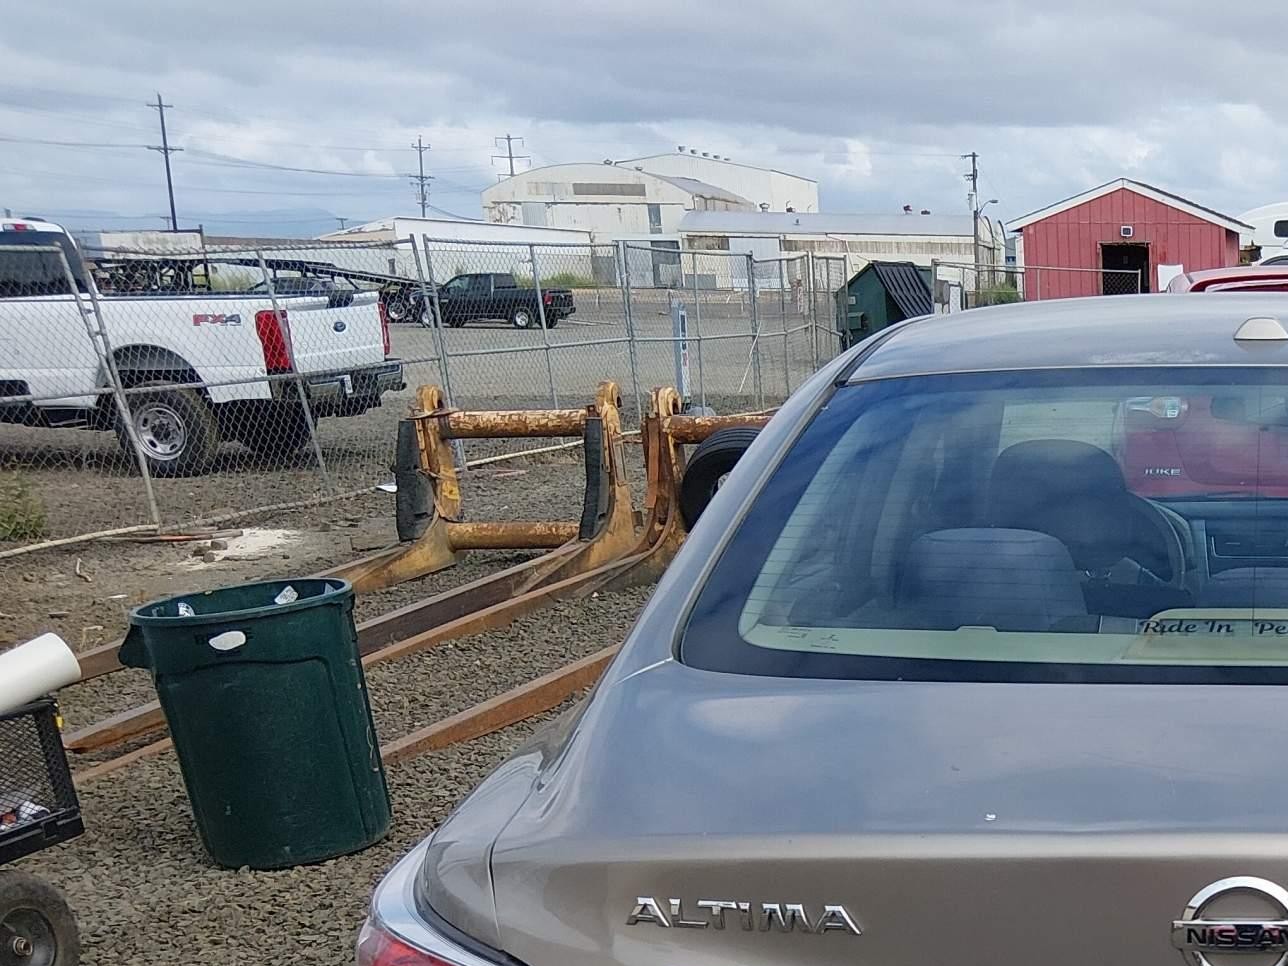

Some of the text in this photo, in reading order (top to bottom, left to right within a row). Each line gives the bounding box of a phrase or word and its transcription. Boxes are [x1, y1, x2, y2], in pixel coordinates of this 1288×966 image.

[192, 313, 241, 326] FX4
[1139, 620, 1198, 636] Ride
[1203, 620, 1233, 635] In
[626, 897, 862, 935] ALTIMA
